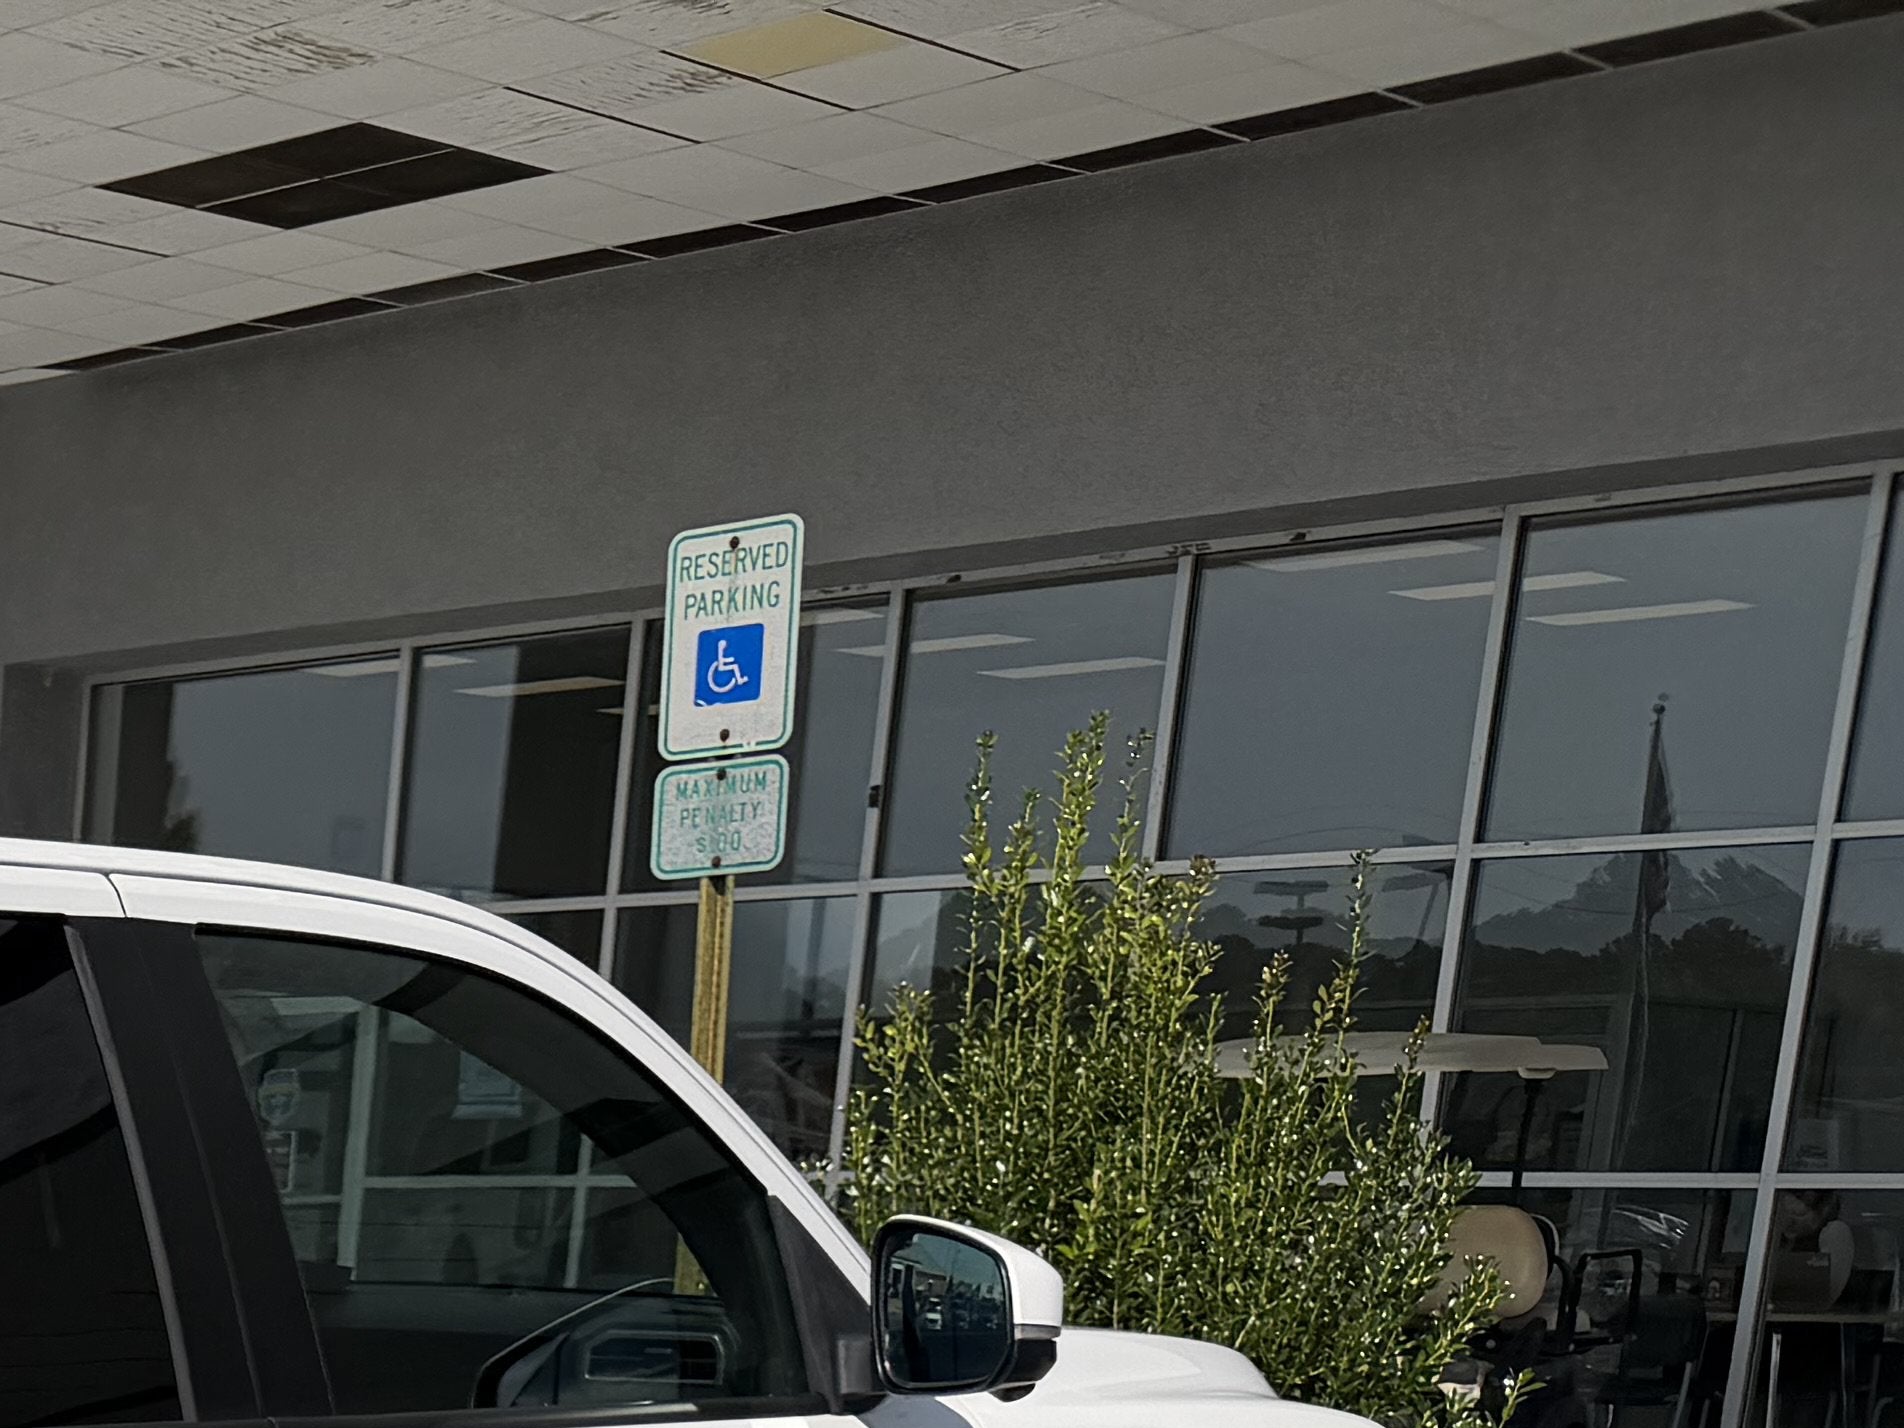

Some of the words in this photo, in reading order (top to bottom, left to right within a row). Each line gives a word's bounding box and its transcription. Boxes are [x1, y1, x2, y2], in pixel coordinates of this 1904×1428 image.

[679, 541, 789, 583] RESERVED
[683, 580, 781, 621] PARKING
[675, 770, 768, 801] MAXIMUM
[679, 801, 763, 828] PENALTY
